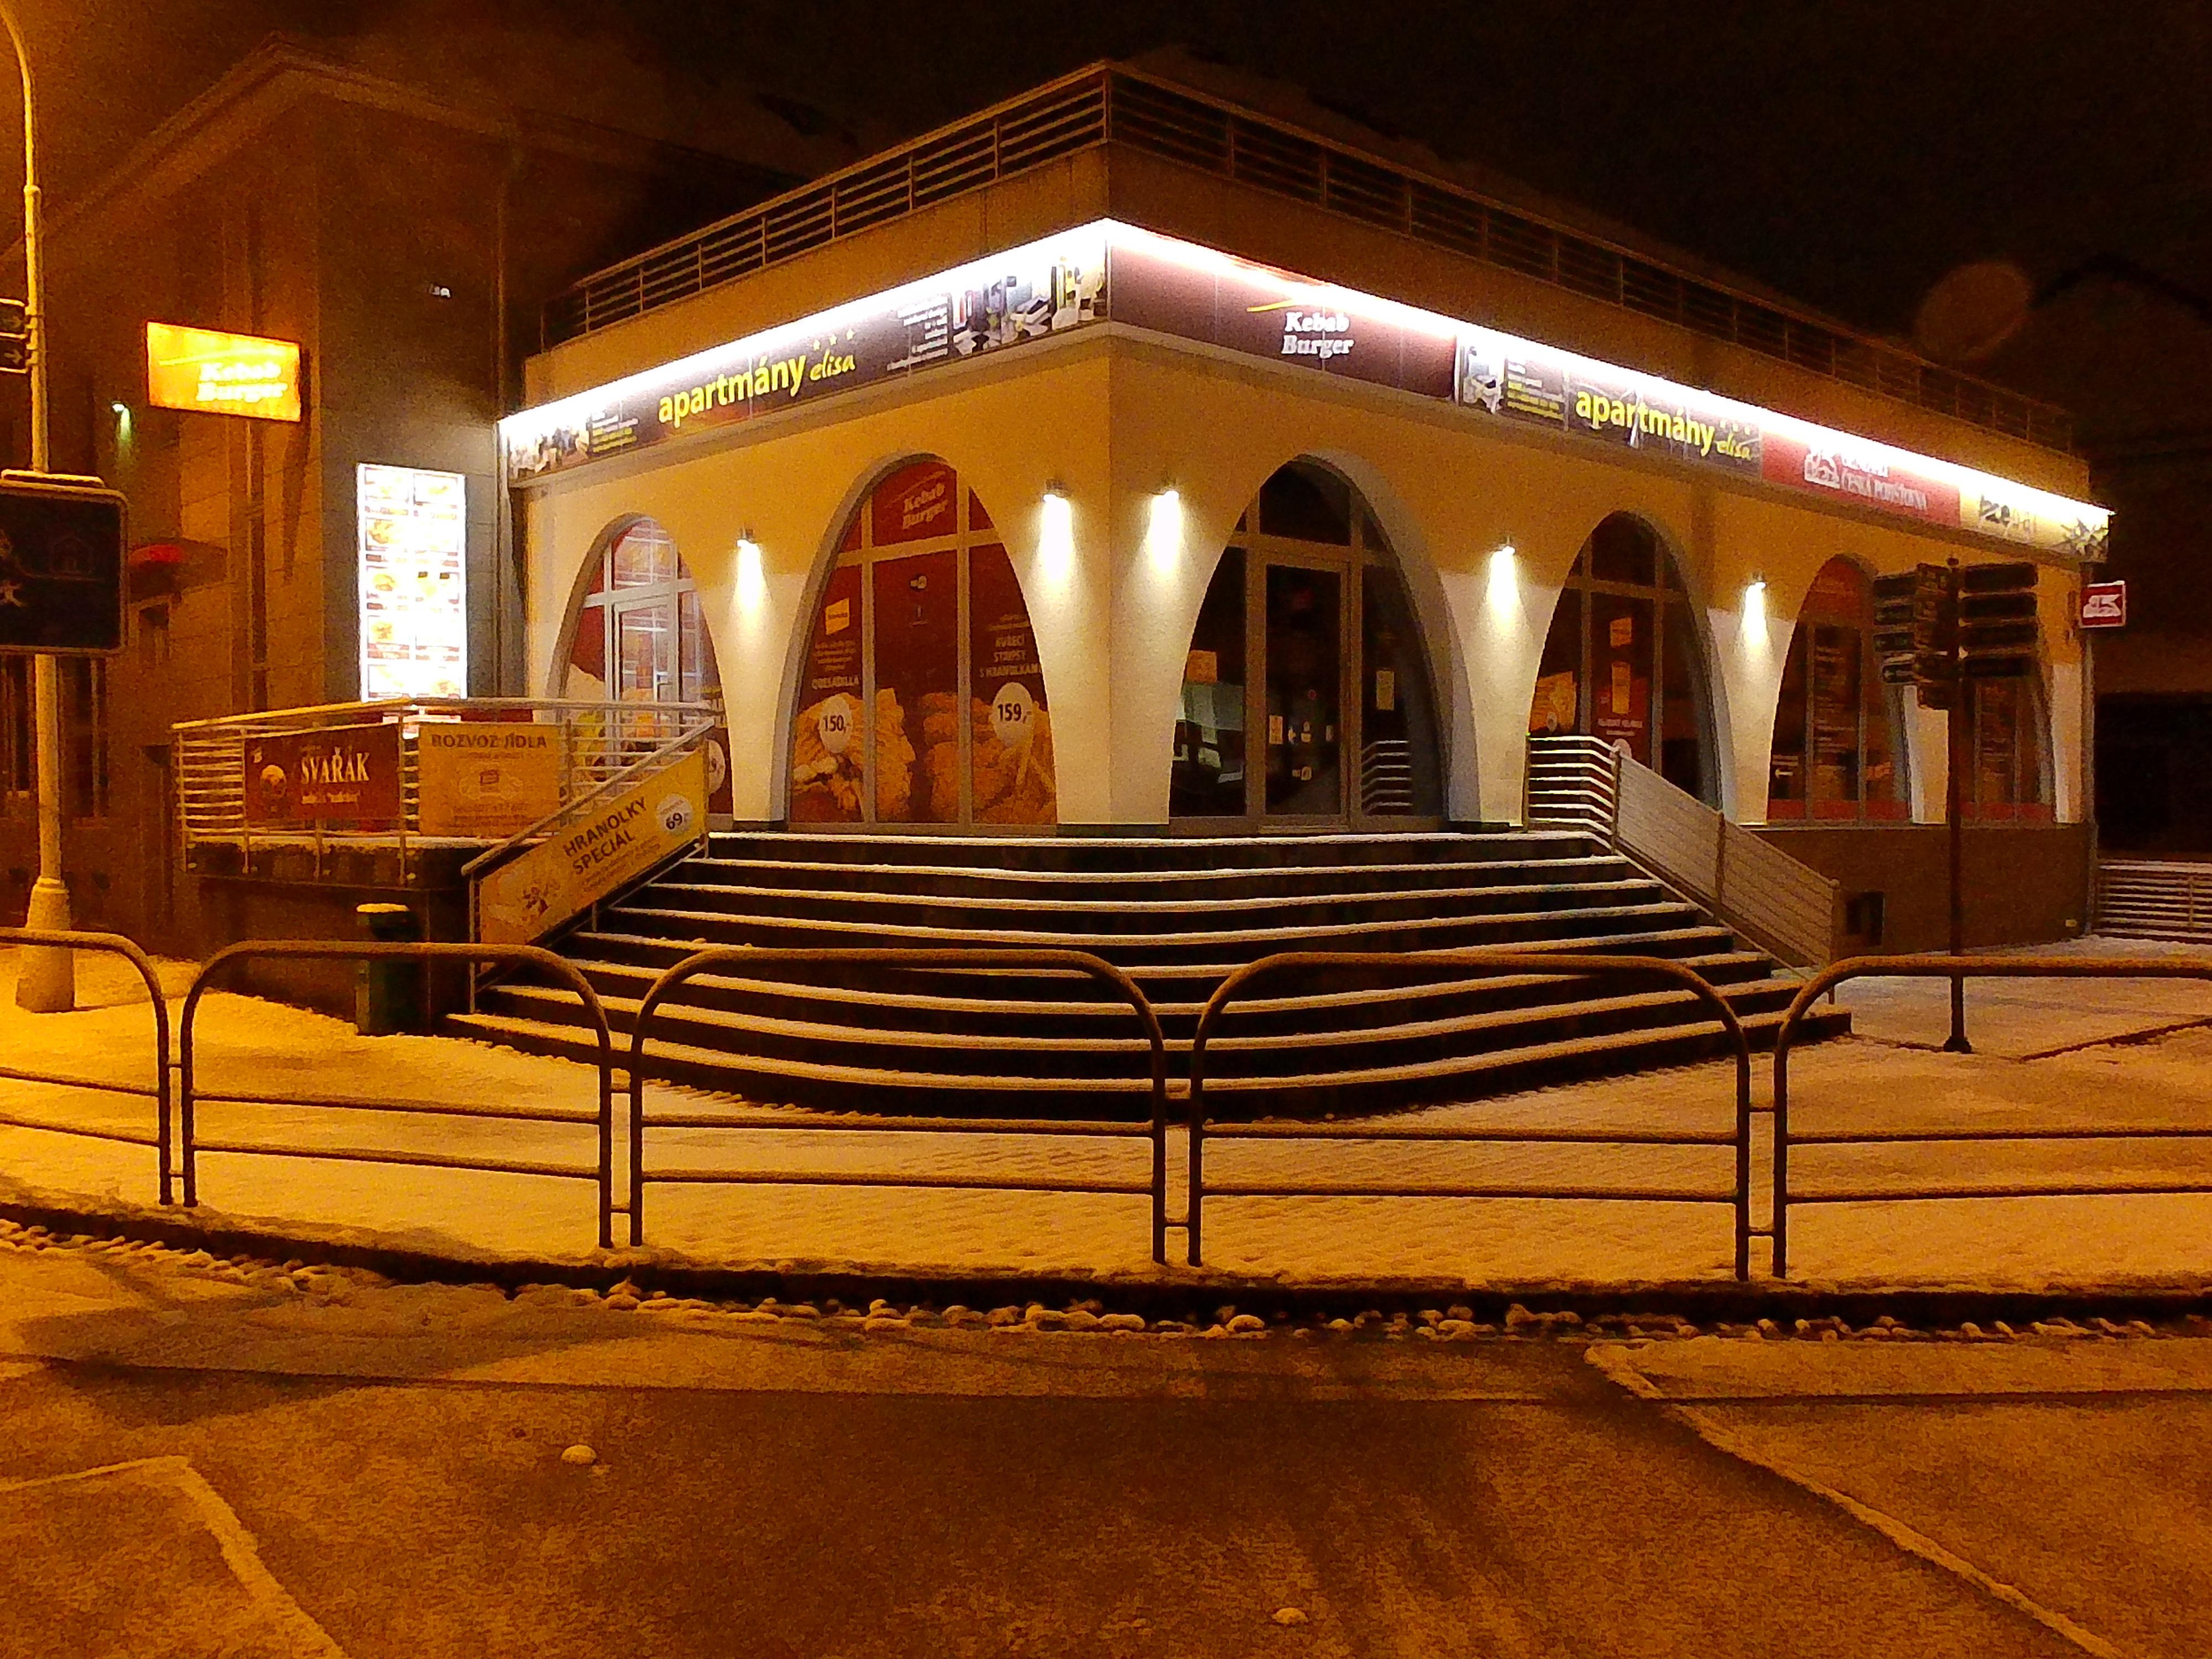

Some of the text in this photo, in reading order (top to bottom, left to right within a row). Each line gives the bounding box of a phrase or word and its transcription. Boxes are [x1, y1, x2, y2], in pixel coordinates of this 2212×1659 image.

[1285, 311, 1350, 332] Kebab
[1281, 335, 1354, 359] Burger
[200, 362, 281, 381] Kebab
[196, 382, 288, 403] Burger
[659, 348, 855, 427] apartmány elisa
[1575, 390, 1715, 457] apartmány
[904, 483, 945, 513] Kebab
[431, 734, 498, 748] ROZVOZ
[564, 796, 646, 857] HRANOLKY
[665, 812, 683, 830] 69
